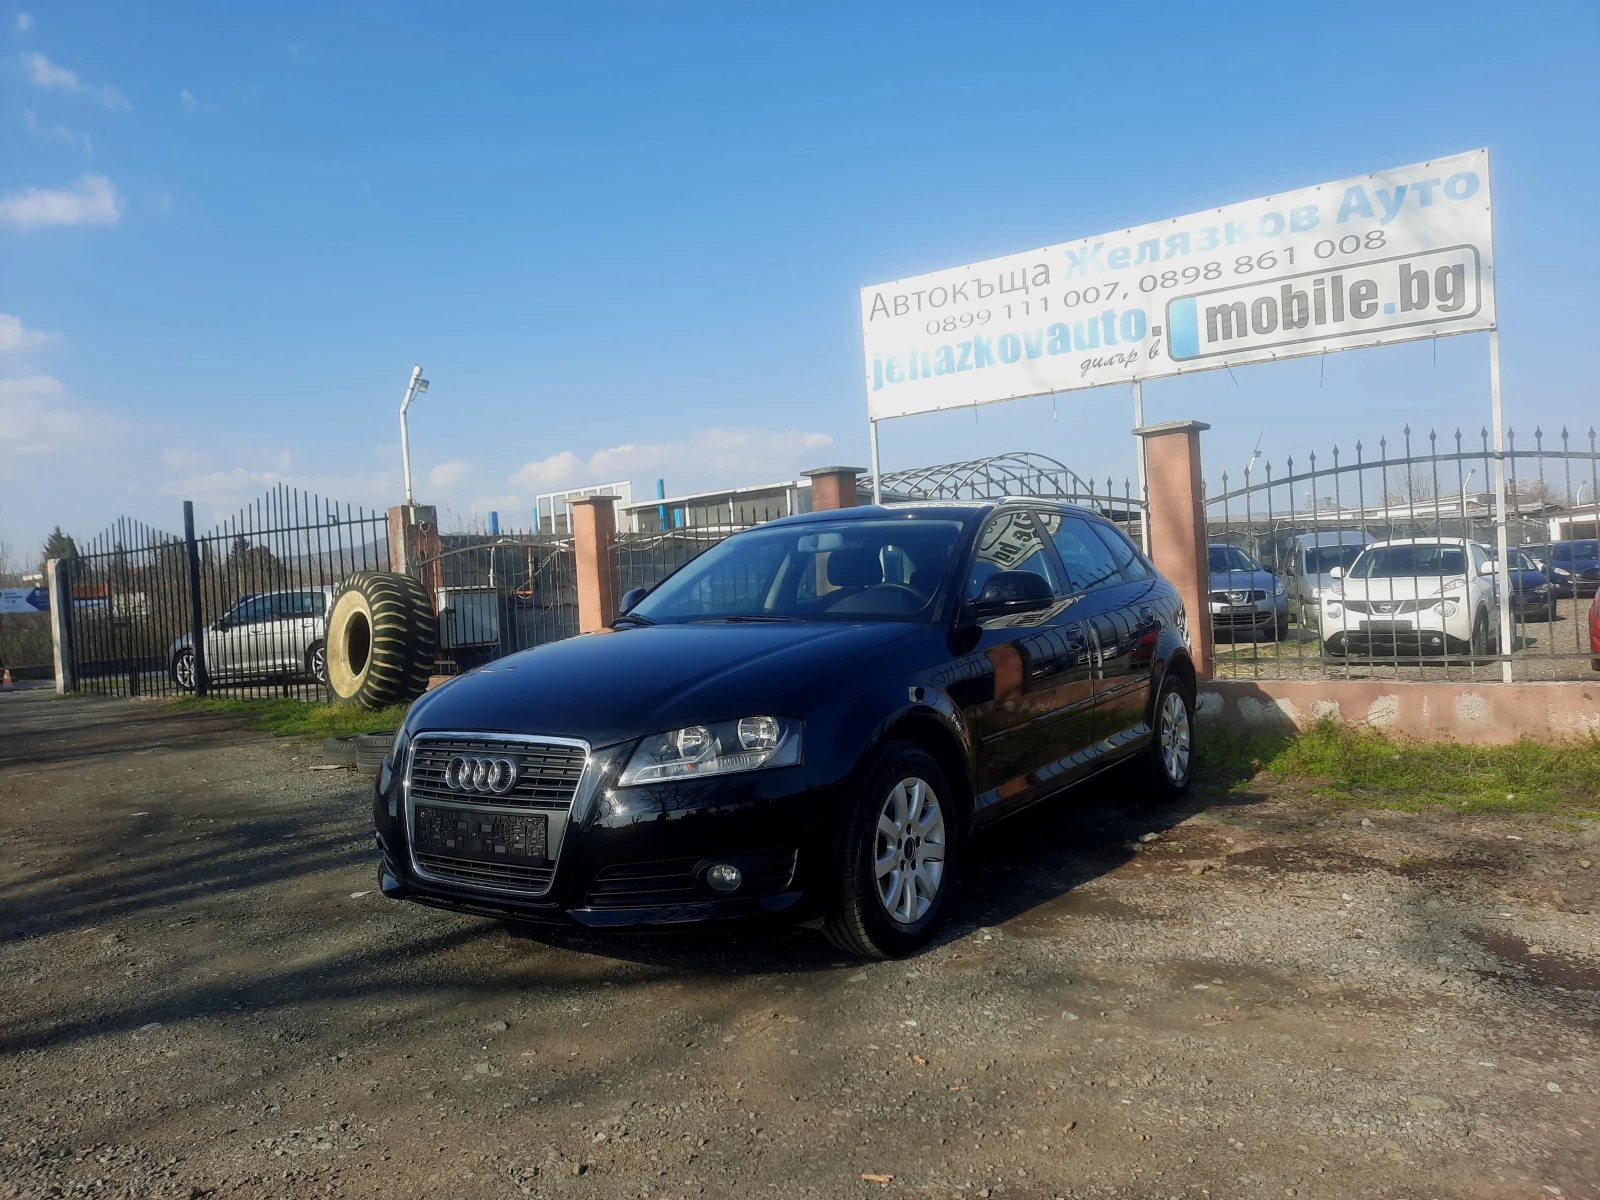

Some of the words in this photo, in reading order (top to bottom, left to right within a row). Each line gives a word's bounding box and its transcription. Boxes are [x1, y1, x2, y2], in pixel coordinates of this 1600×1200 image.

[869, 263, 1051, 322] Автокъща
[1063, 204, 1321, 280] Желязков
[1334, 171, 1481, 227] Ауто
[925, 308, 992, 335] 0899
[1003, 296, 1049, 320] 111
[1063, 281, 1129, 308] 007,
[1138, 261, 1223, 293] 0898
[1233, 246, 1295, 275] 861
[1313, 229, 1387, 259] 008
[1205, 262, 1466, 343] mobile.bg
